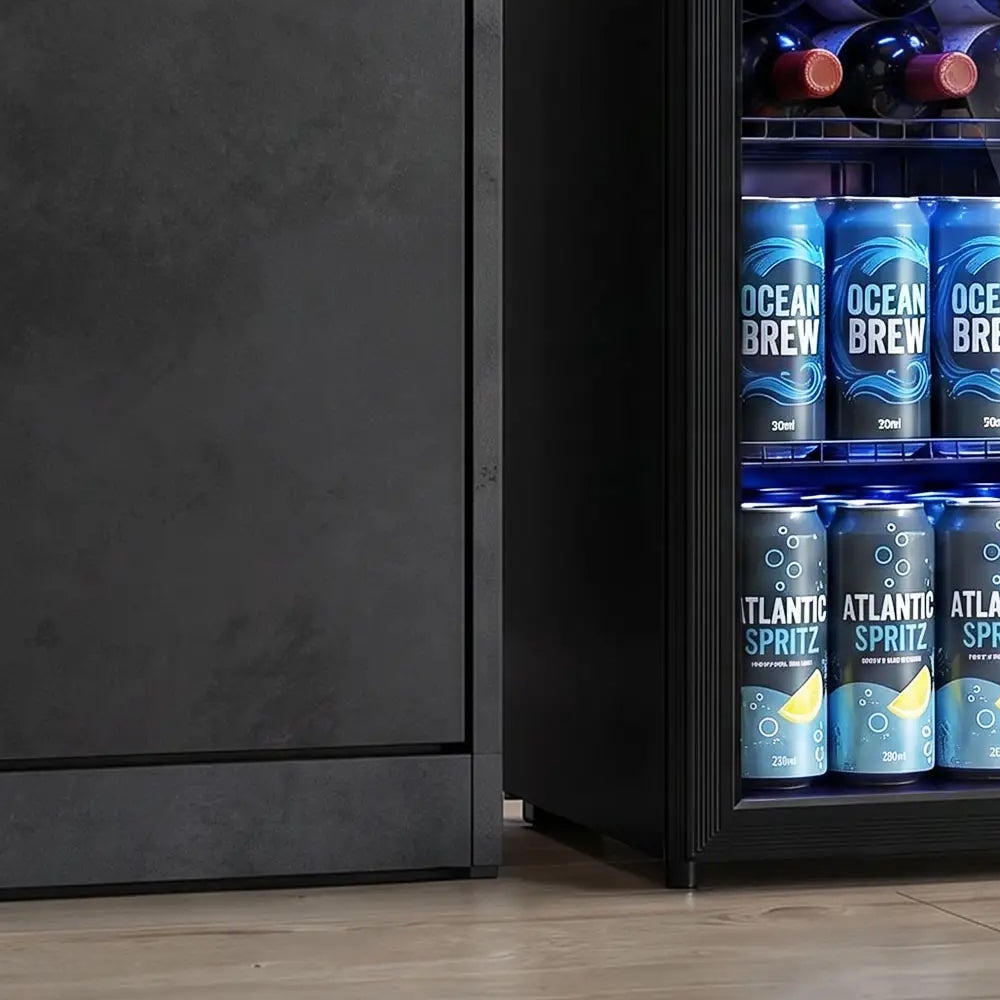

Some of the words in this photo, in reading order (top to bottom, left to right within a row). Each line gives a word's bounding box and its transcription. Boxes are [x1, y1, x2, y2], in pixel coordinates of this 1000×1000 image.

[741, 284, 820, 317] OCEAN
[847, 283, 926, 316] OCEAN
[742, 318, 820, 356] BREW
[849, 317, 926, 355] BREW
[842, 591, 934, 622] ATLANTIC
[745, 626, 820, 656] SPRITZ
[855, 623, 928, 653] SPRITZ
